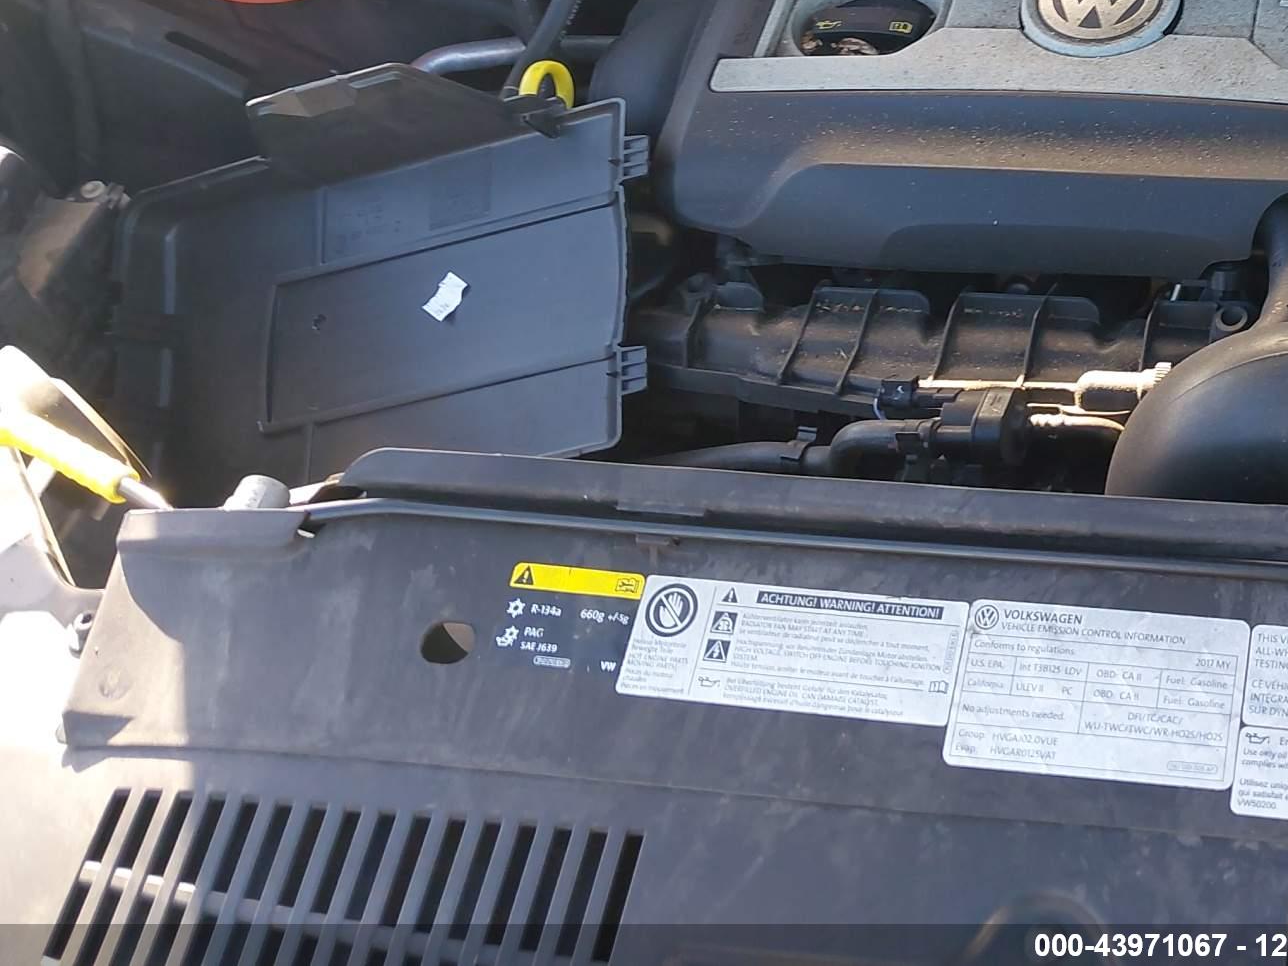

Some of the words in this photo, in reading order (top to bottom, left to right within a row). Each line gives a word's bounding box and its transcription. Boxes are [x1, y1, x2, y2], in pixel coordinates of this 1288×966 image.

[761, 593, 817, 607] ACHTUNG!
[818, 598, 876, 612] WARNING!
[877, 603, 940, 618] ATTENTION!
[530, 603, 562, 617] R-134a
[580, 608, 605, 624] 660g
[1003, 609, 1083, 625] VOLKSWAGEN
[523, 626, 545, 638] PAG
[1001, 621, 1036, 632] VEHICLE
[1037, 624, 1080, 636] EMISSION
[1081, 628, 1122, 640] CONTROL
[1124, 631, 1187, 645] INFORMATION
[1257, 633, 1279, 644] THIS
[520, 641, 536, 652] SAE
[974, 639, 1014, 651] Conforms
[1016, 642, 1025, 651] to
[600, 660, 617, 672] VW
[1195, 658, 1215, 668] 2017
[1215, 659, 1232, 670] MY
[1064, 666, 1083, 676] LDV
[1121, 671, 1135, 681] CA
[1190, 676, 1229, 689] Gasoline
[962, 704, 976, 713] No
[1248, 704, 1268, 716] SUR
[1243, 747, 1257, 756] Use
